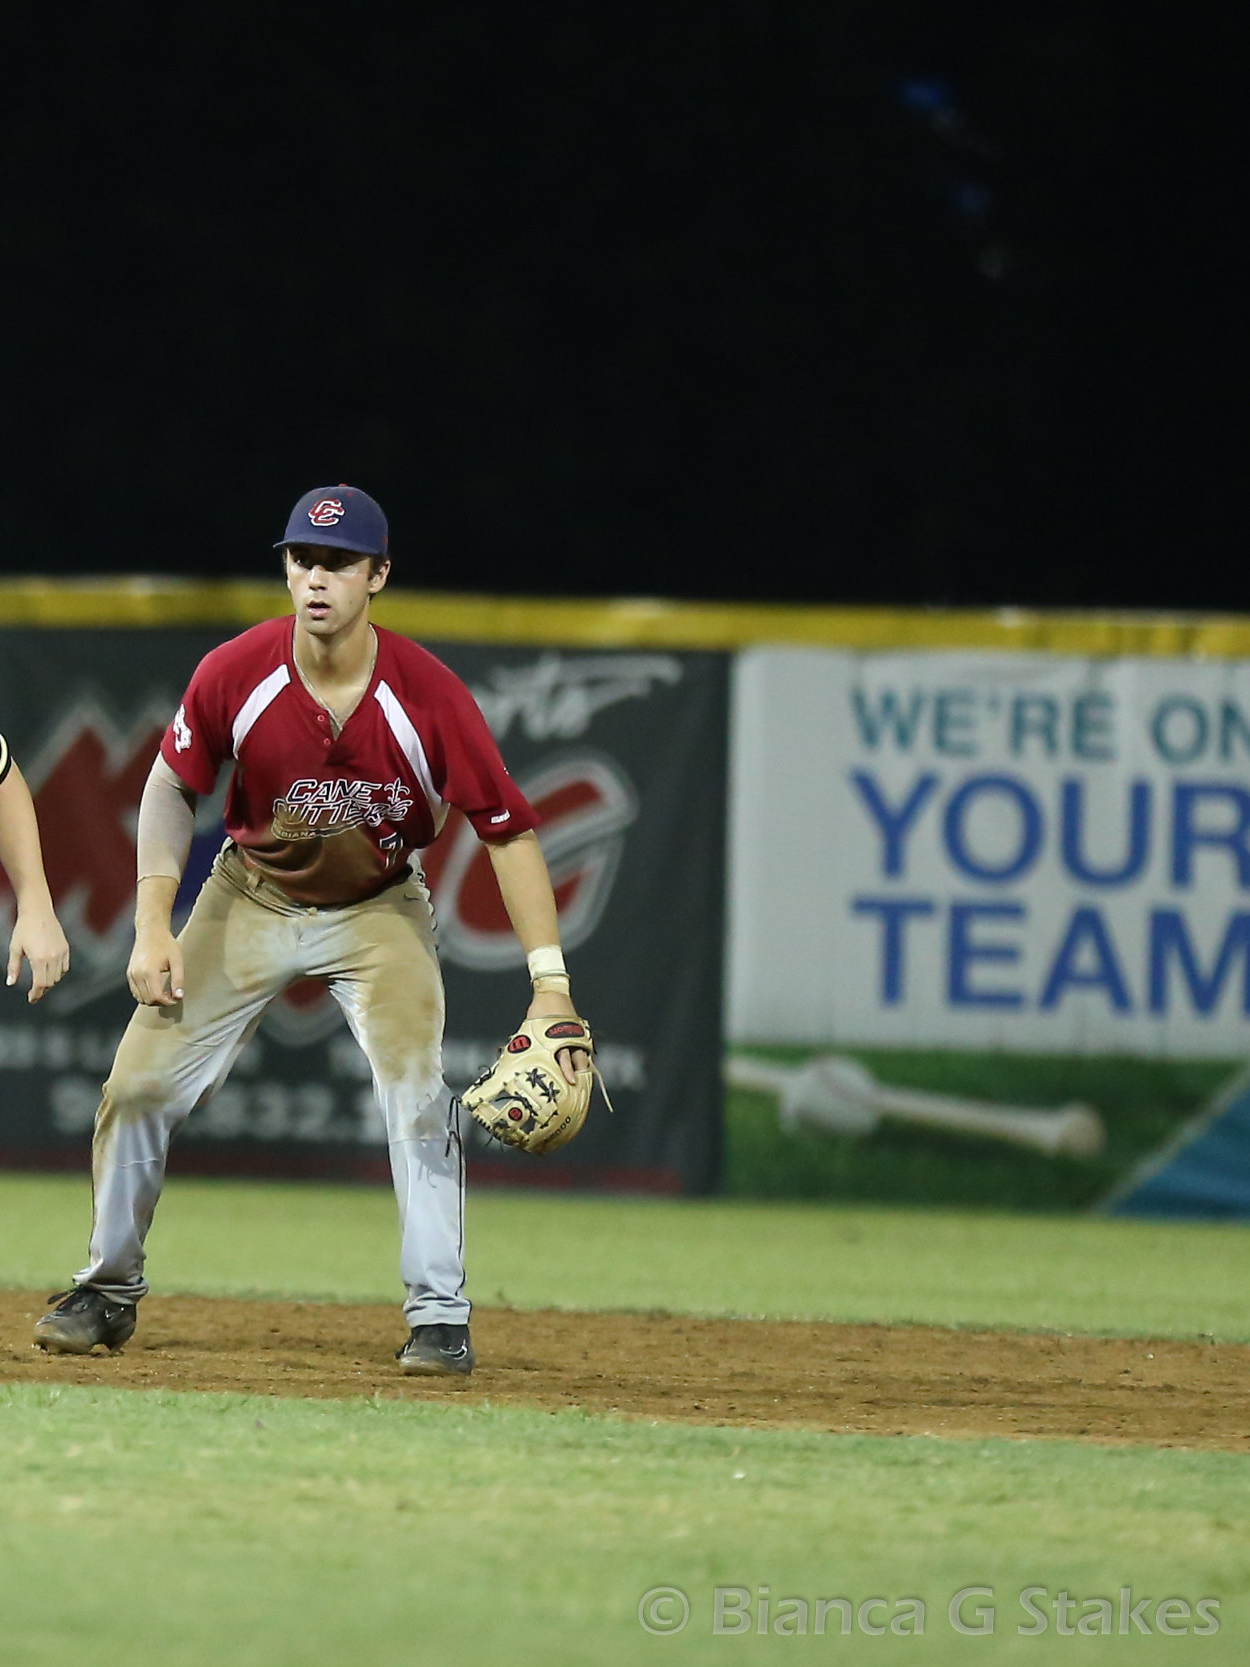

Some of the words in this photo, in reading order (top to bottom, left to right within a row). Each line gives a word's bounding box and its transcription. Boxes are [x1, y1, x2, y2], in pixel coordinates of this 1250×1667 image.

[852, 688, 1116, 763] WE'RE
[286, 779, 383, 803] CANE
[851, 769, 1250, 890] YOUR
[851, 896, 1250, 1018] TEAM
